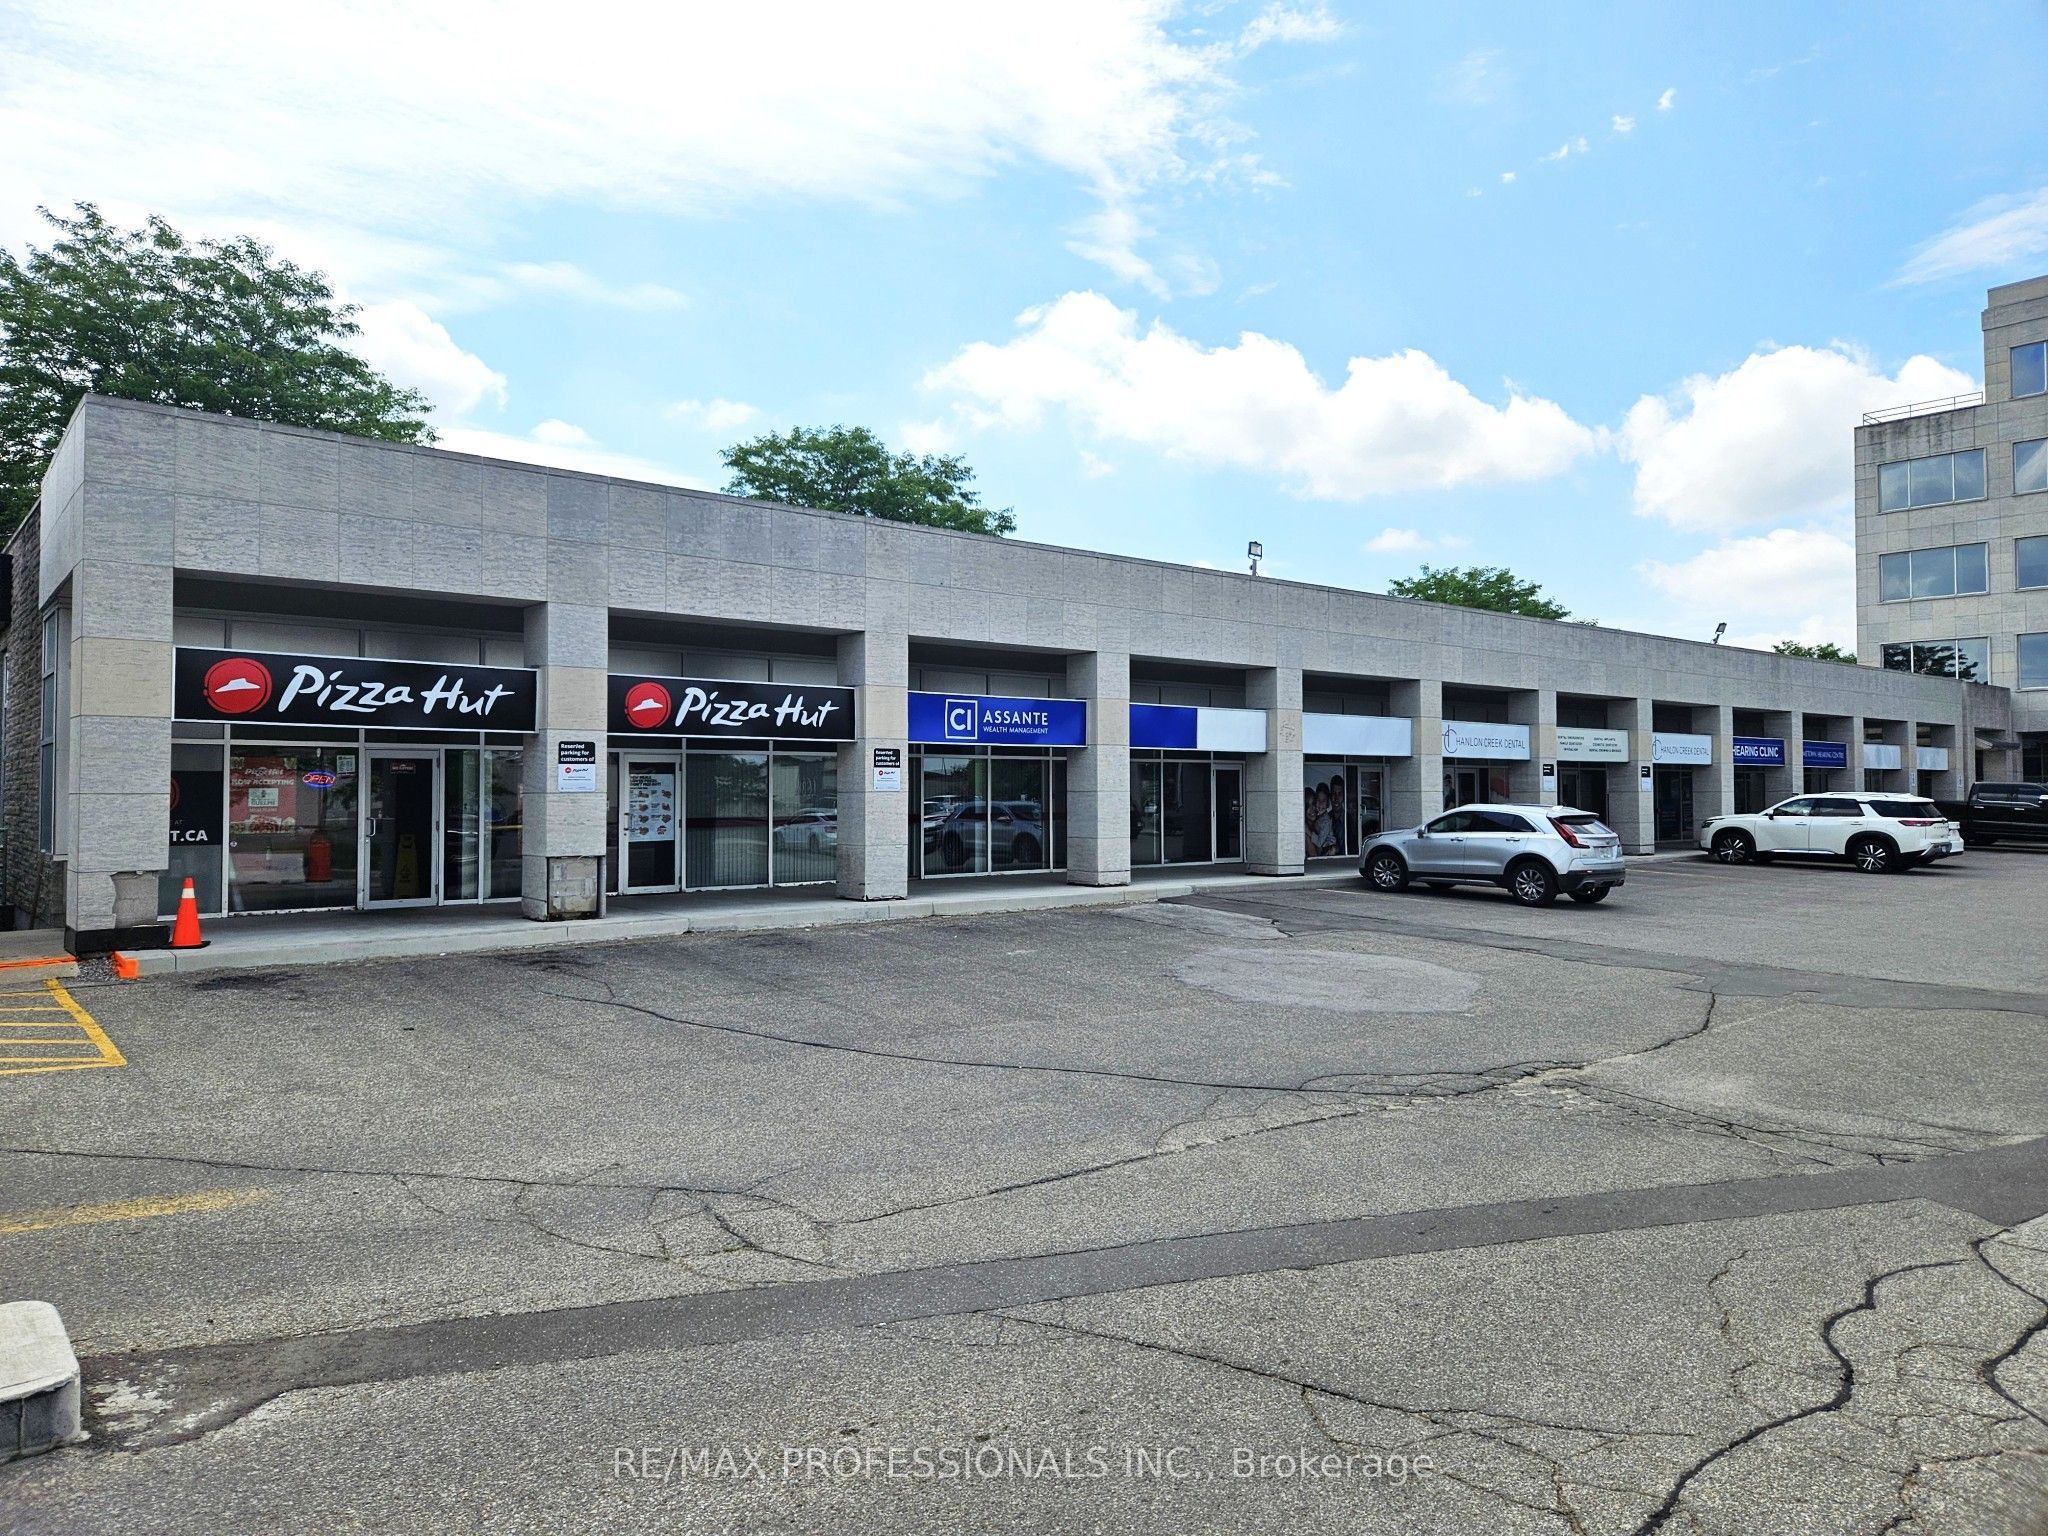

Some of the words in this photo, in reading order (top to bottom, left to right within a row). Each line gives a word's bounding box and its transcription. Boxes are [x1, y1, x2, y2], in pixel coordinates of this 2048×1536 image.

[278, 665, 415, 713] Pizza
[420, 674, 516, 716] Hut
[674, 686, 771, 727] Pizza
[774, 693, 840, 728] Hut
[950, 708, 972, 731] CI
[983, 709, 1049, 726] ASSANTE
[983, 725, 1008, 733] WEALTH
[1009, 727, 1049, 735] MANAGEMENT
[1456, 736, 1483, 747] HANLON
[1484, 737, 1503, 748] CREEK
[1504, 739, 1526, 749] DENTAL
[1760, 746, 1779, 758] CLINIC
[252, 778, 295, 786] ACCEPTING
[302, 774, 336, 784] OPEN
